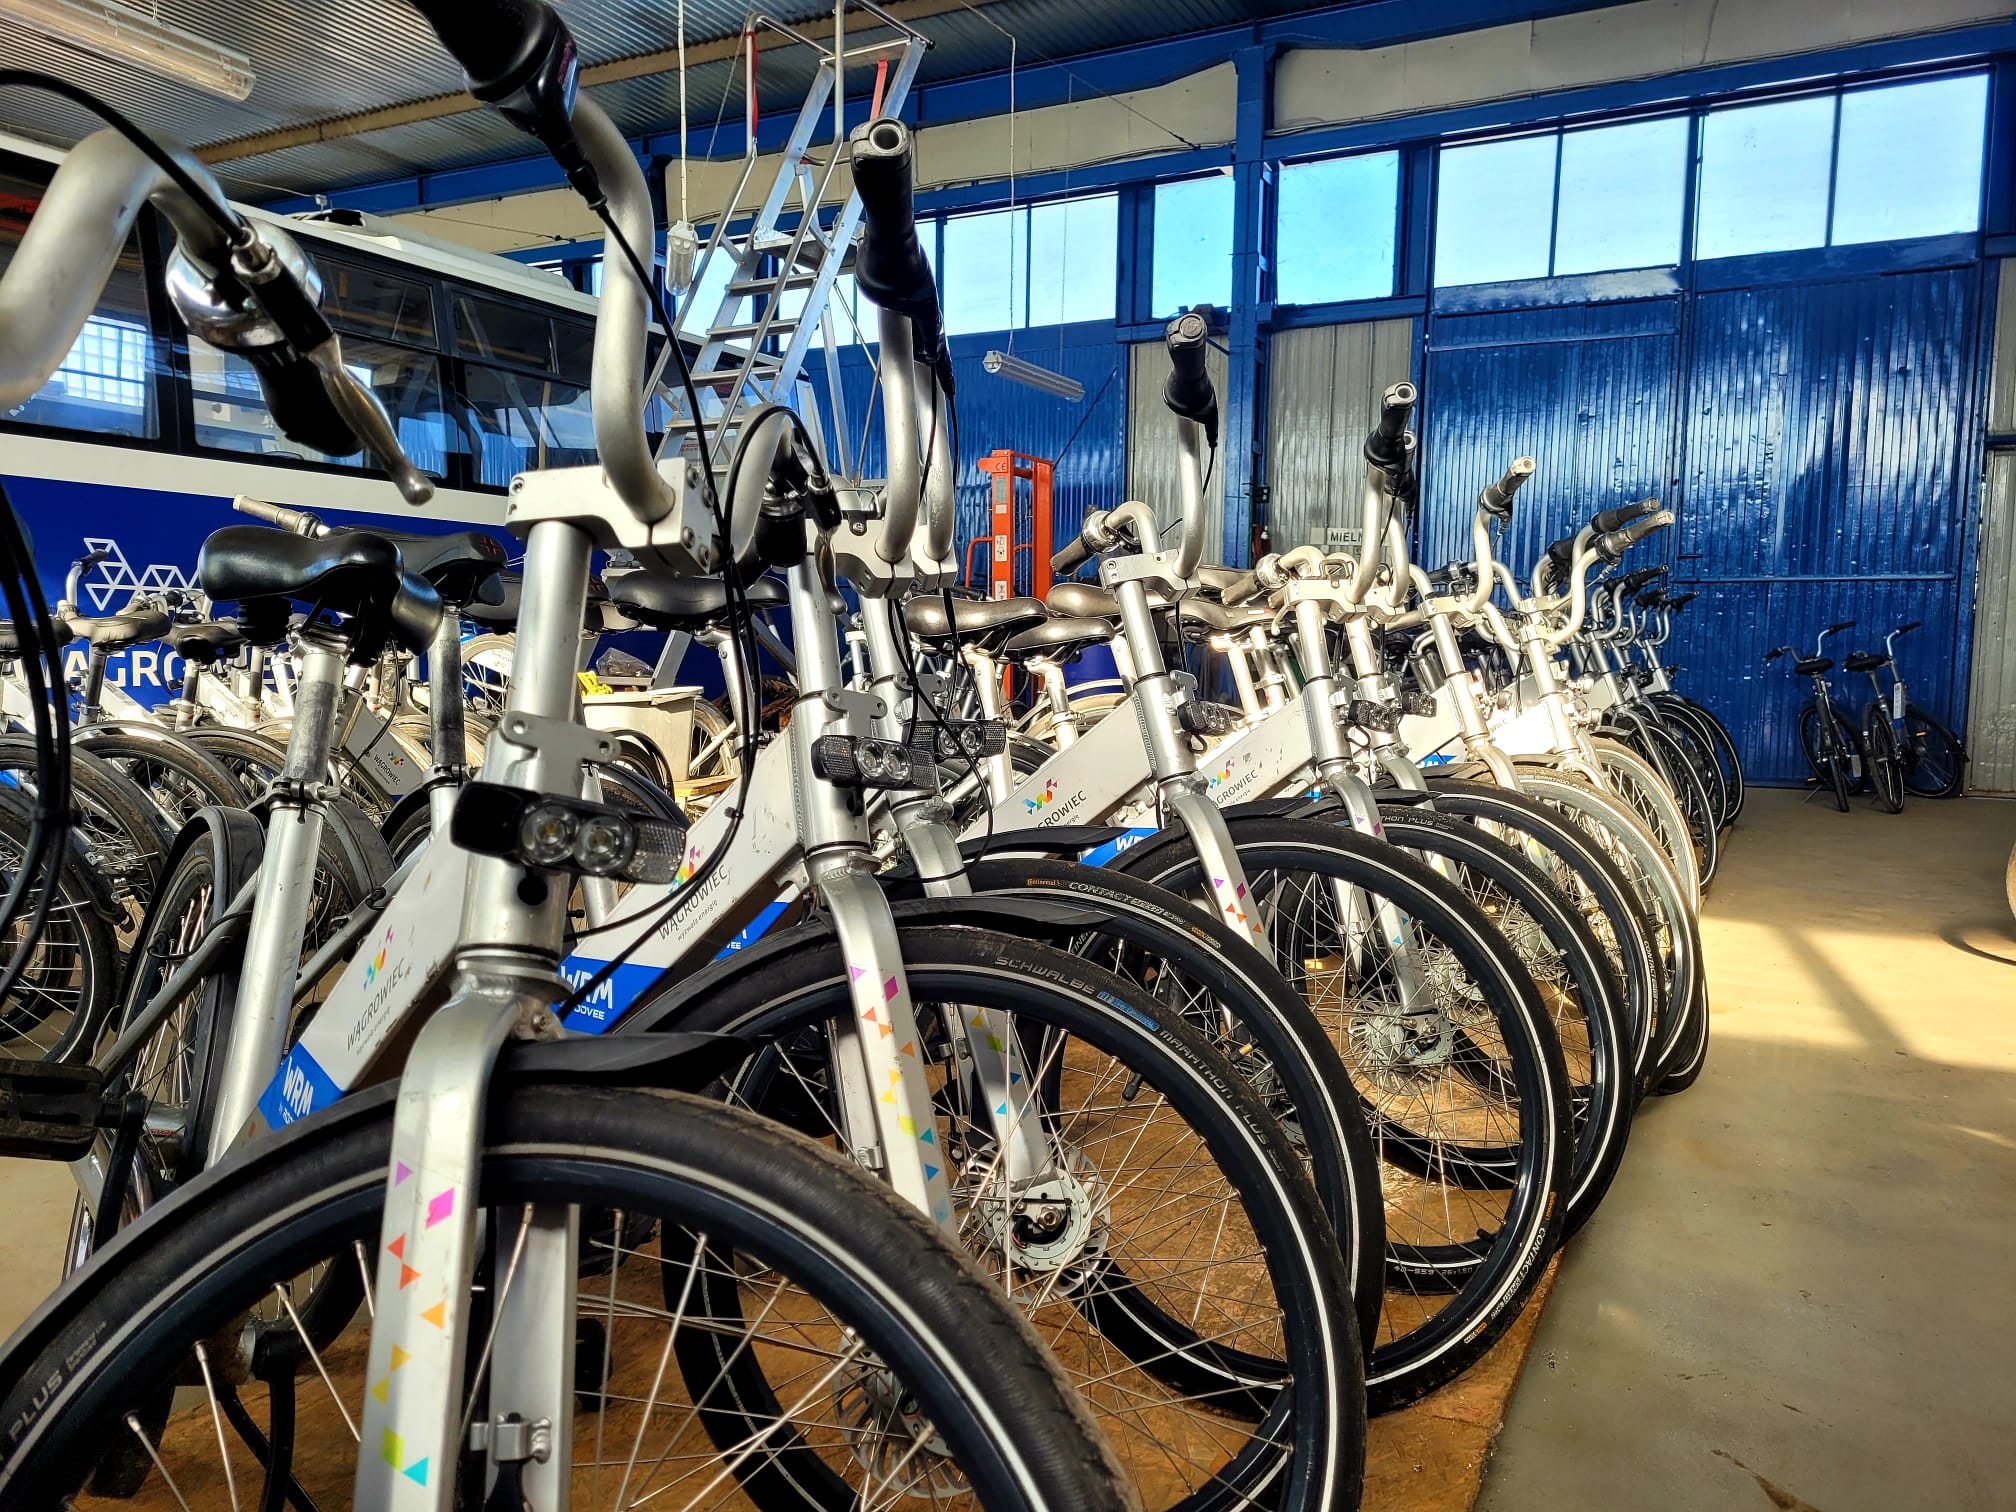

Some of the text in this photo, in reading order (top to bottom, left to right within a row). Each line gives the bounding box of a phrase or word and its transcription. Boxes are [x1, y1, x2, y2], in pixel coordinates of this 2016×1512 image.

[995, 463, 1007, 471] CE
[1408, 818, 1434, 826] PLUS
[994, 956, 1096, 995] SCHWALBE
[1160, 1030, 1233, 1099] MARATHON
[1518, 1227, 1547, 1280] CONTACT
[8, 1369, 63, 1443] PLUS
